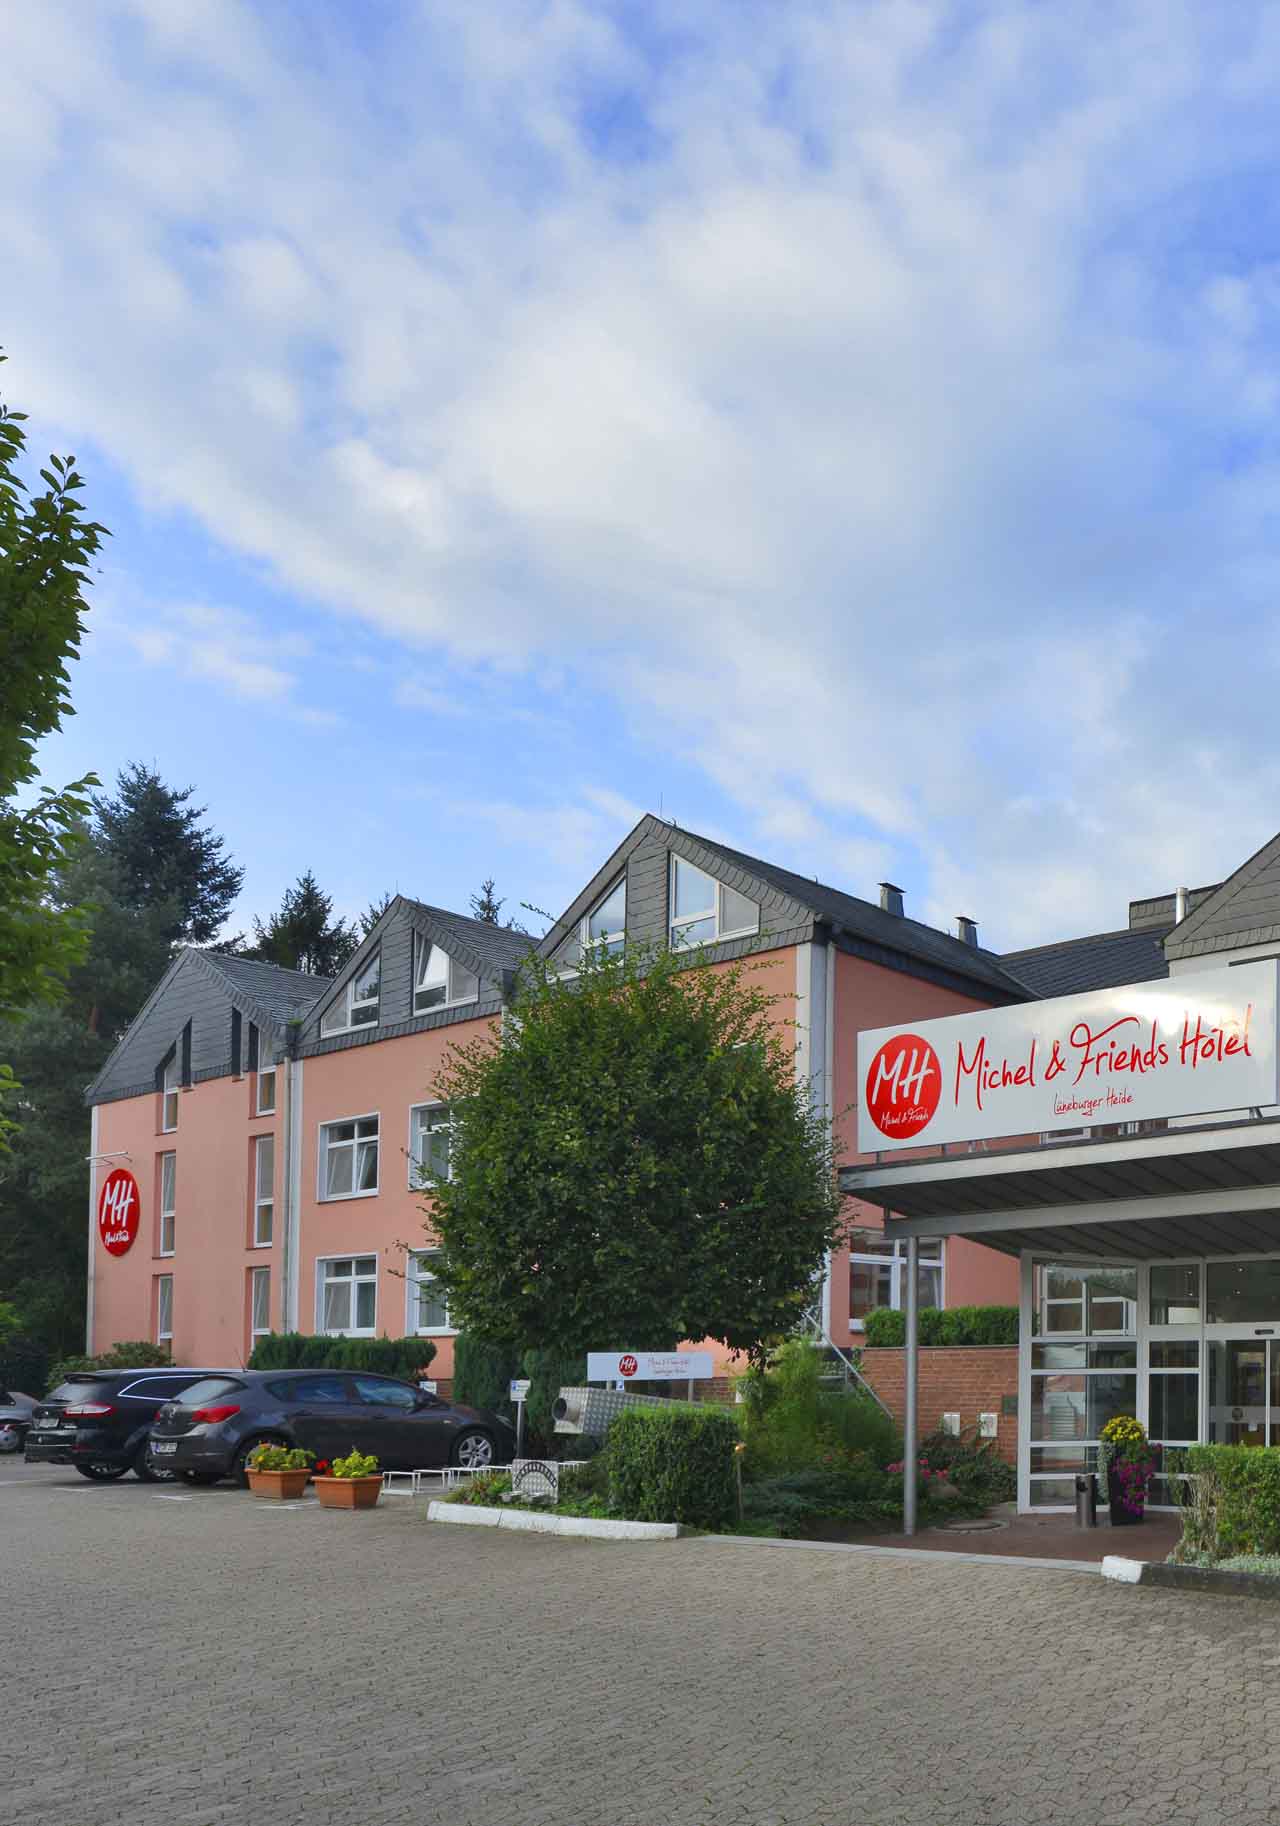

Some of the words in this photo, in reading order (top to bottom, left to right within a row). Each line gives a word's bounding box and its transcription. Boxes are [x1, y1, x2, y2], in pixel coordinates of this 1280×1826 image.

[871, 1047, 936, 1106] MH
[955, 1036, 1036, 1111] Michel
[1044, 1040, 1066, 1081] &
[1070, 1016, 1169, 1086] Friends
[1179, 1003, 1252, 1069] Hotel
[1106, 1087, 1134, 1108] Heide
[101, 1180, 134, 1227] MH
